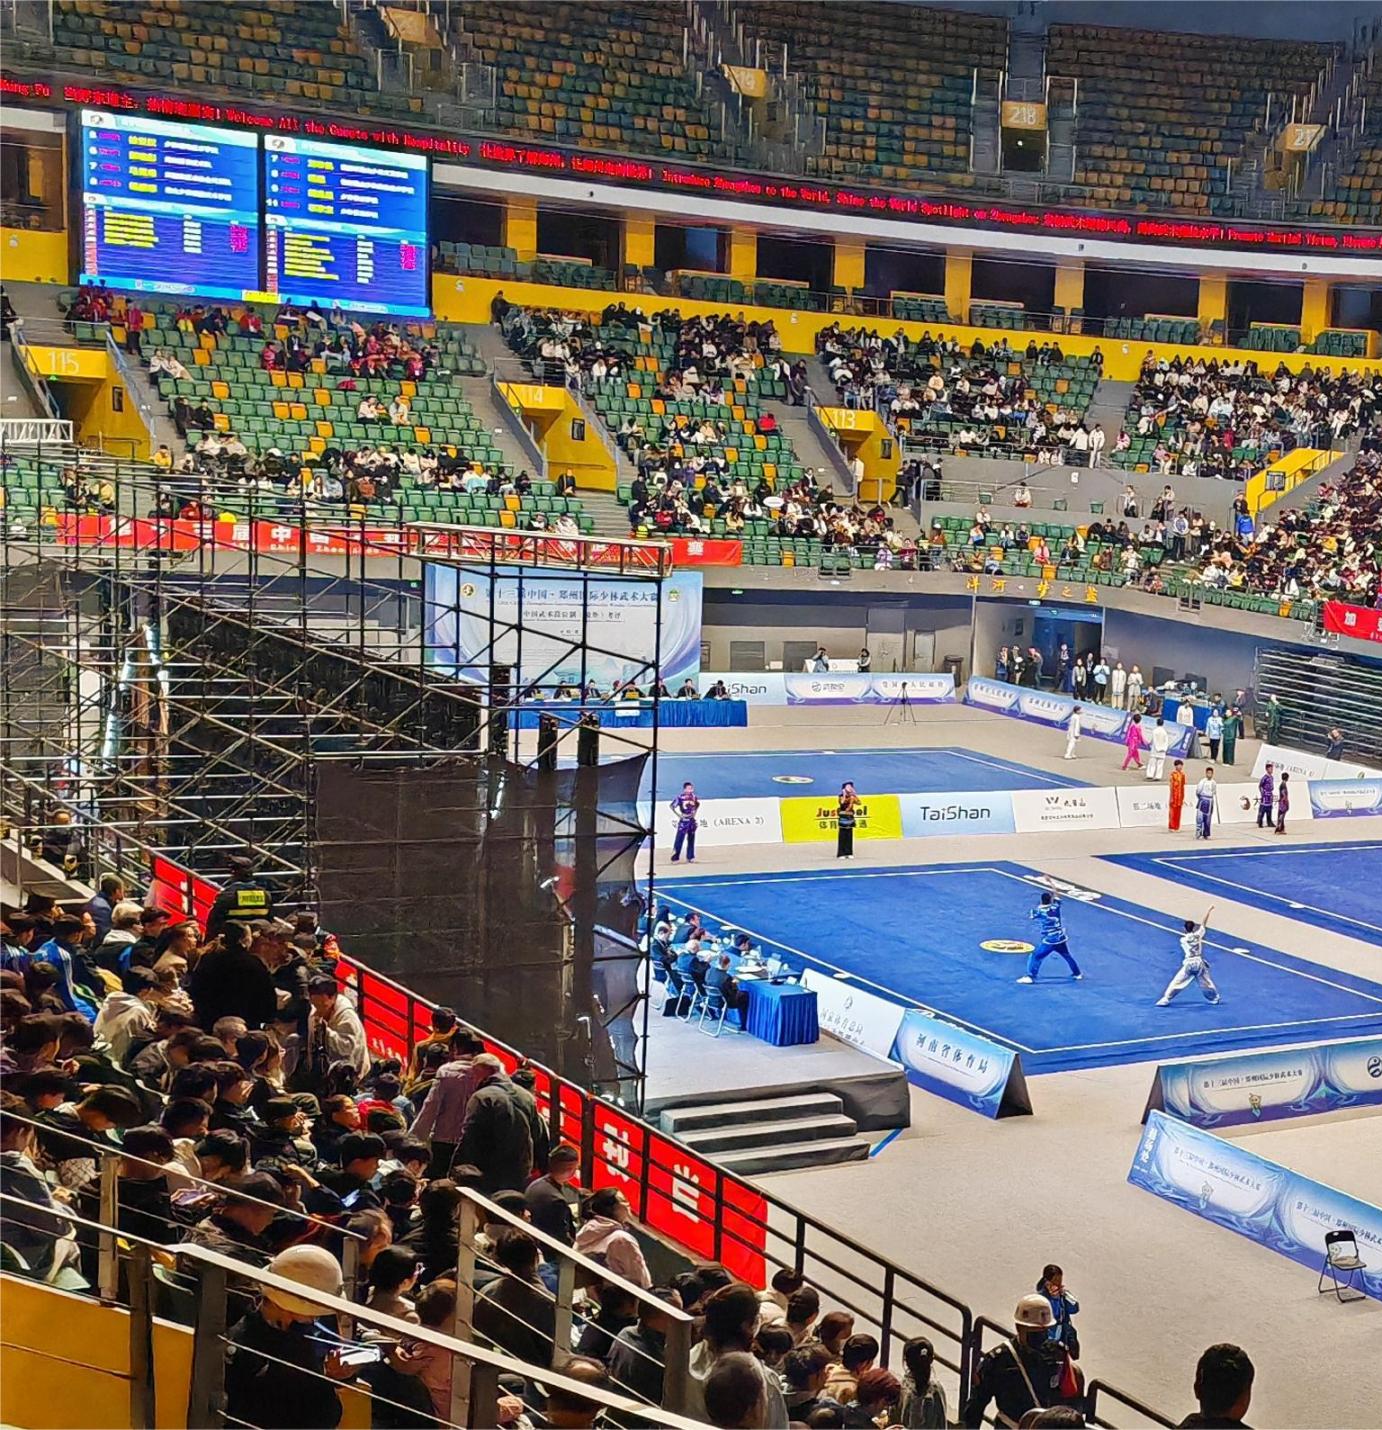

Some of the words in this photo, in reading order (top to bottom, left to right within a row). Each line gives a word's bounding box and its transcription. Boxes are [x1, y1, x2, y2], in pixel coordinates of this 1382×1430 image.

[1008, 106, 1035, 125] 218
[49, 353, 80, 373] 115
[920, 805, 991, 821] TaiShan
